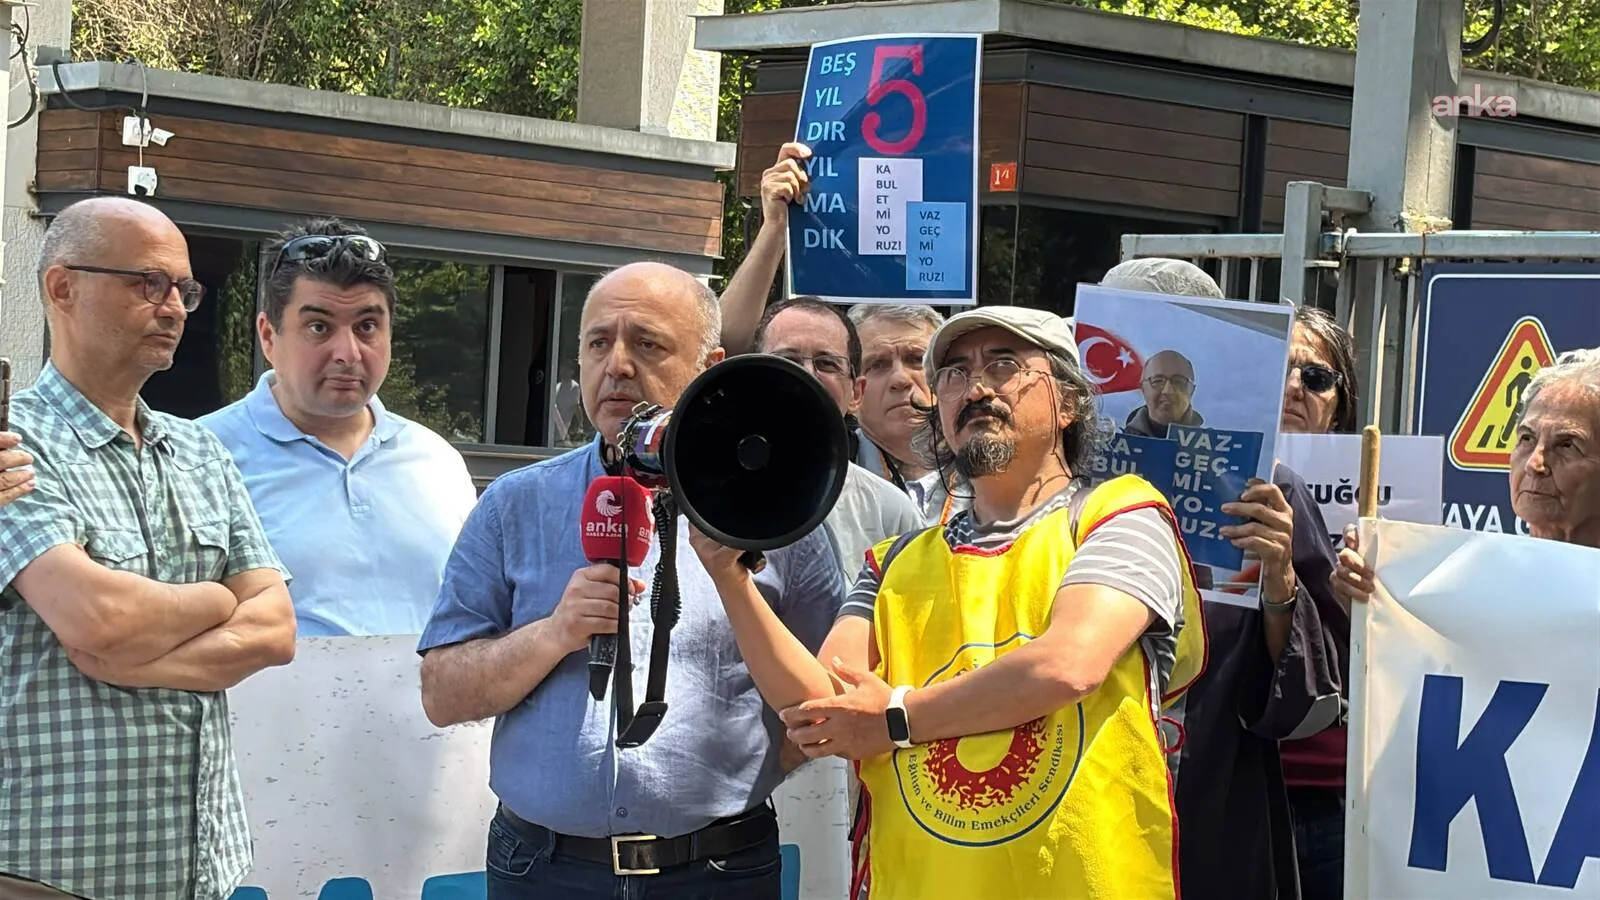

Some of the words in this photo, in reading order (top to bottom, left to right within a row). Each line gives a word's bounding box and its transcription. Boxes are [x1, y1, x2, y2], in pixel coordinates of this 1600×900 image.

[820, 52, 857, 76] BEŞ
[815, 88, 843, 108] YIL
[861, 44, 927, 155] 5
[807, 121, 846, 142] DIR
[804, 156, 839, 177] YIL
[876, 164, 891, 175] KA
[876, 179, 898, 190] BUL
[803, 192, 847, 214] MA
[876, 195, 889, 205] ET
[876, 208, 891, 220] Mİ
[919, 210, 941, 221] VAZ
[803, 228, 846, 250] DIK
[876, 225, 891, 236] YO
[919, 226, 941, 238] GEÇ
[876, 240, 902, 251] RUZ!
[919, 239, 934, 251] Mİ
[919, 256, 934, 267] YO
[919, 271, 945, 282] RUZ!
[1178, 430, 1243, 452] VAZ-
[1175, 451, 1239, 477] GEÇ-
[1172, 471, 1212, 492] Mİ-
[1442, 502, 1504, 534] AYA
[934, 809, 965, 829] Bilim
[971, 793, 1041, 830] Emekçileri
